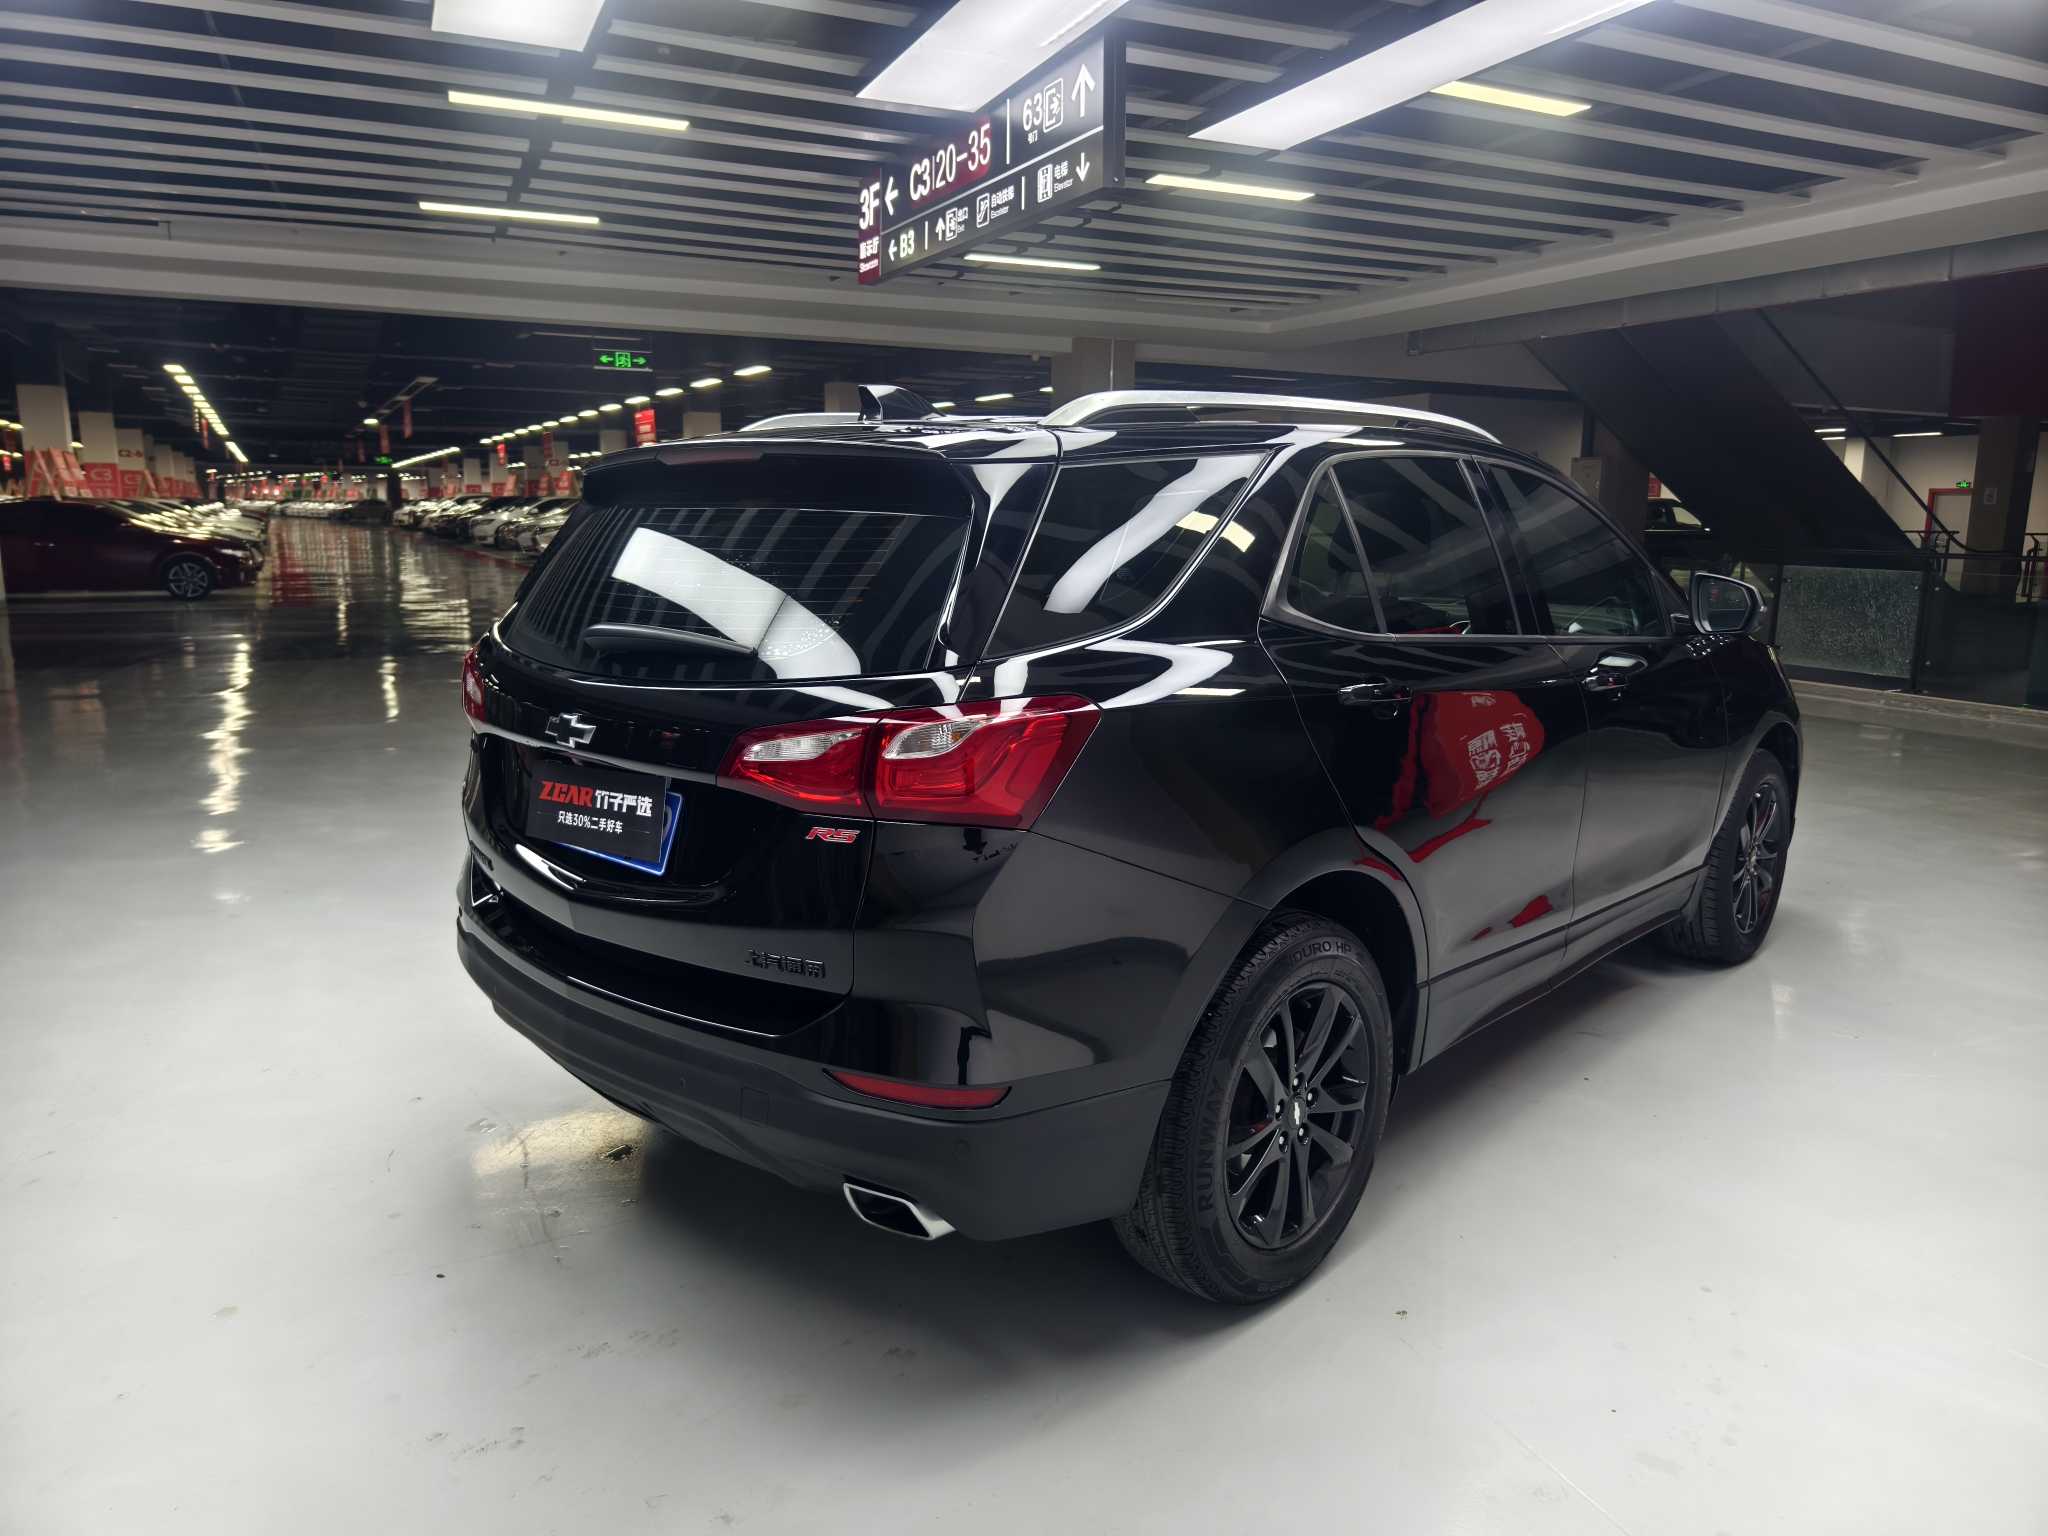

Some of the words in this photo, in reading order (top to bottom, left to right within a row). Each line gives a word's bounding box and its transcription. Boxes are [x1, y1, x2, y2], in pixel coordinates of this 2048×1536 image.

[1022, 92, 1043, 131] 63
[859, 182, 880, 230] 3F
[899, 229, 915, 258] B3
[595, 789, 653, 817] 竹子严选
[557, 810, 623, 834] 只选30%二手好车
[806, 826, 860, 844] RS
